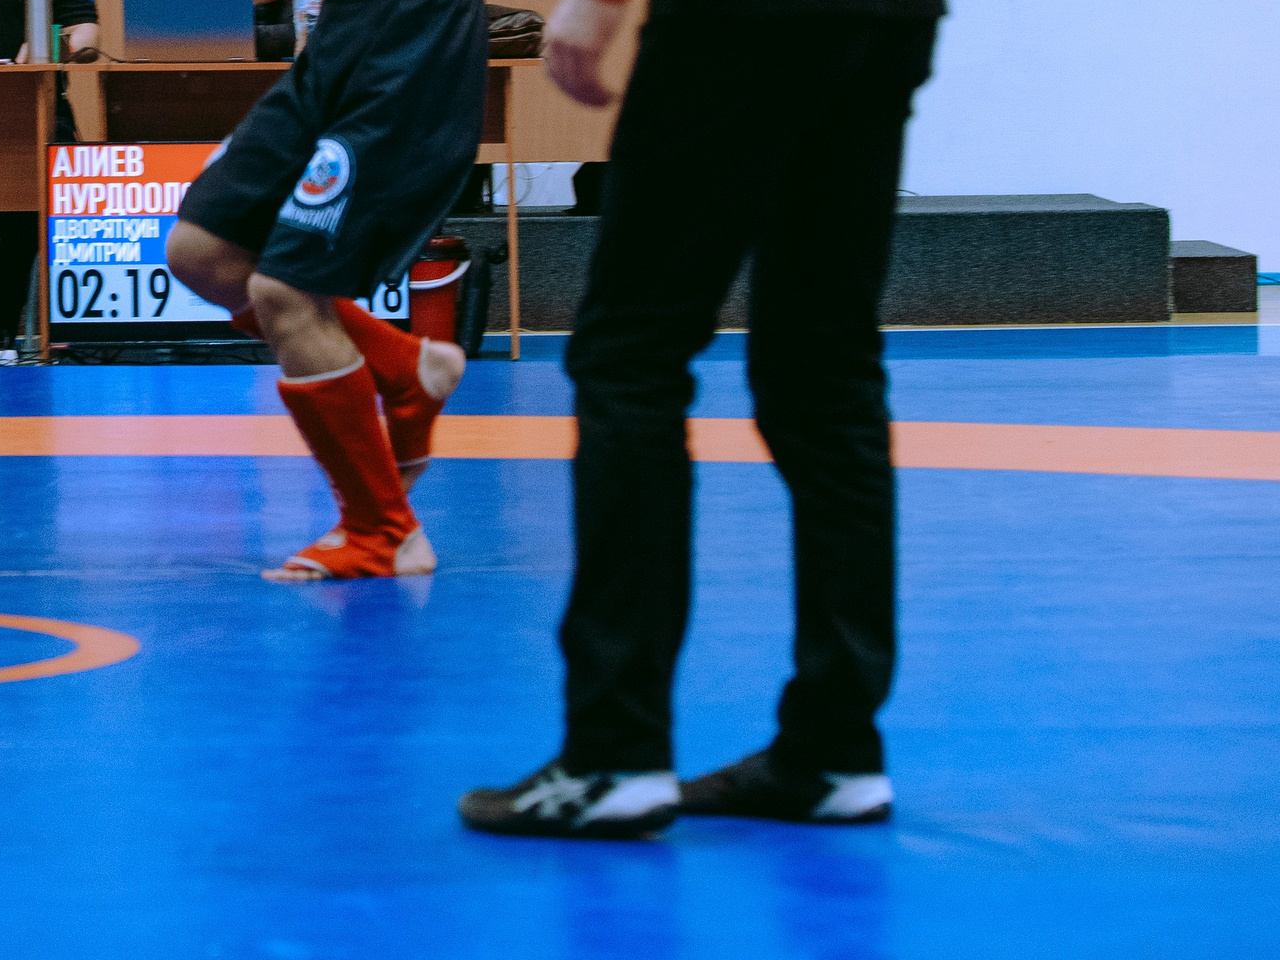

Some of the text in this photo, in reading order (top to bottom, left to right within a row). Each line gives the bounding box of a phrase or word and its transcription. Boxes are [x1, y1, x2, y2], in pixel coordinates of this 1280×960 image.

[52, 146, 144, 178] АЛИЕВ
[52, 218, 160, 243] ДВОРЯТКИН
[58, 268, 170, 318] 02:19
